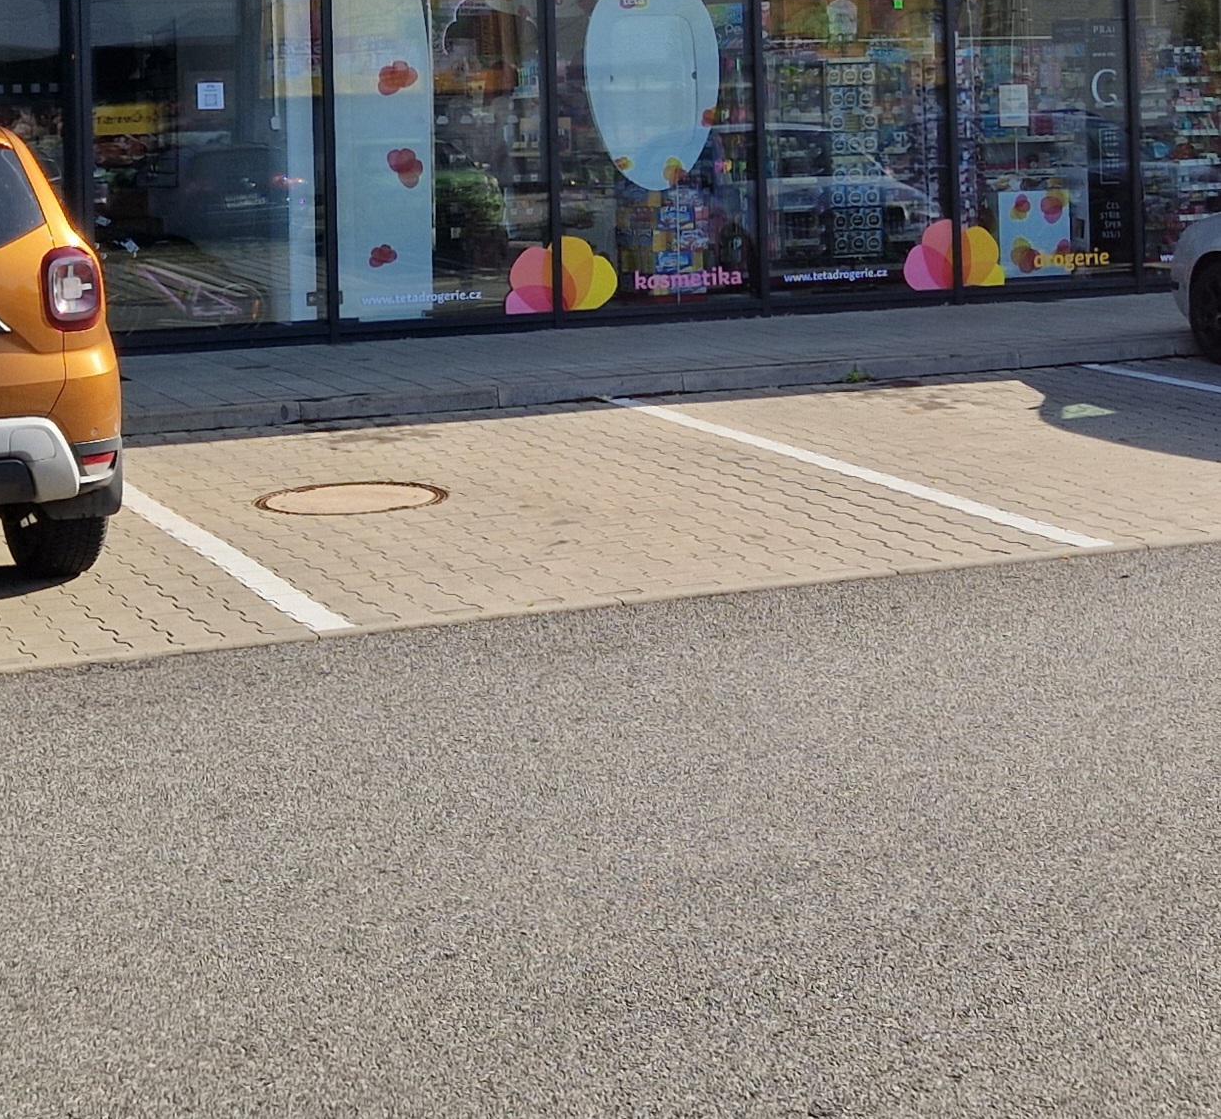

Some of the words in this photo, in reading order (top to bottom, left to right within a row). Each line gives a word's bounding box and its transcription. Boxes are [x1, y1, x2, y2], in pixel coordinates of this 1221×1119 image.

[1033, 247, 1111, 270] drogerie
[634, 266, 743, 290] kosmetika
[784, 268, 889, 282] www.tetadrogerie.cz
[361, 290, 483, 305] www.tetadrogerie.cz
